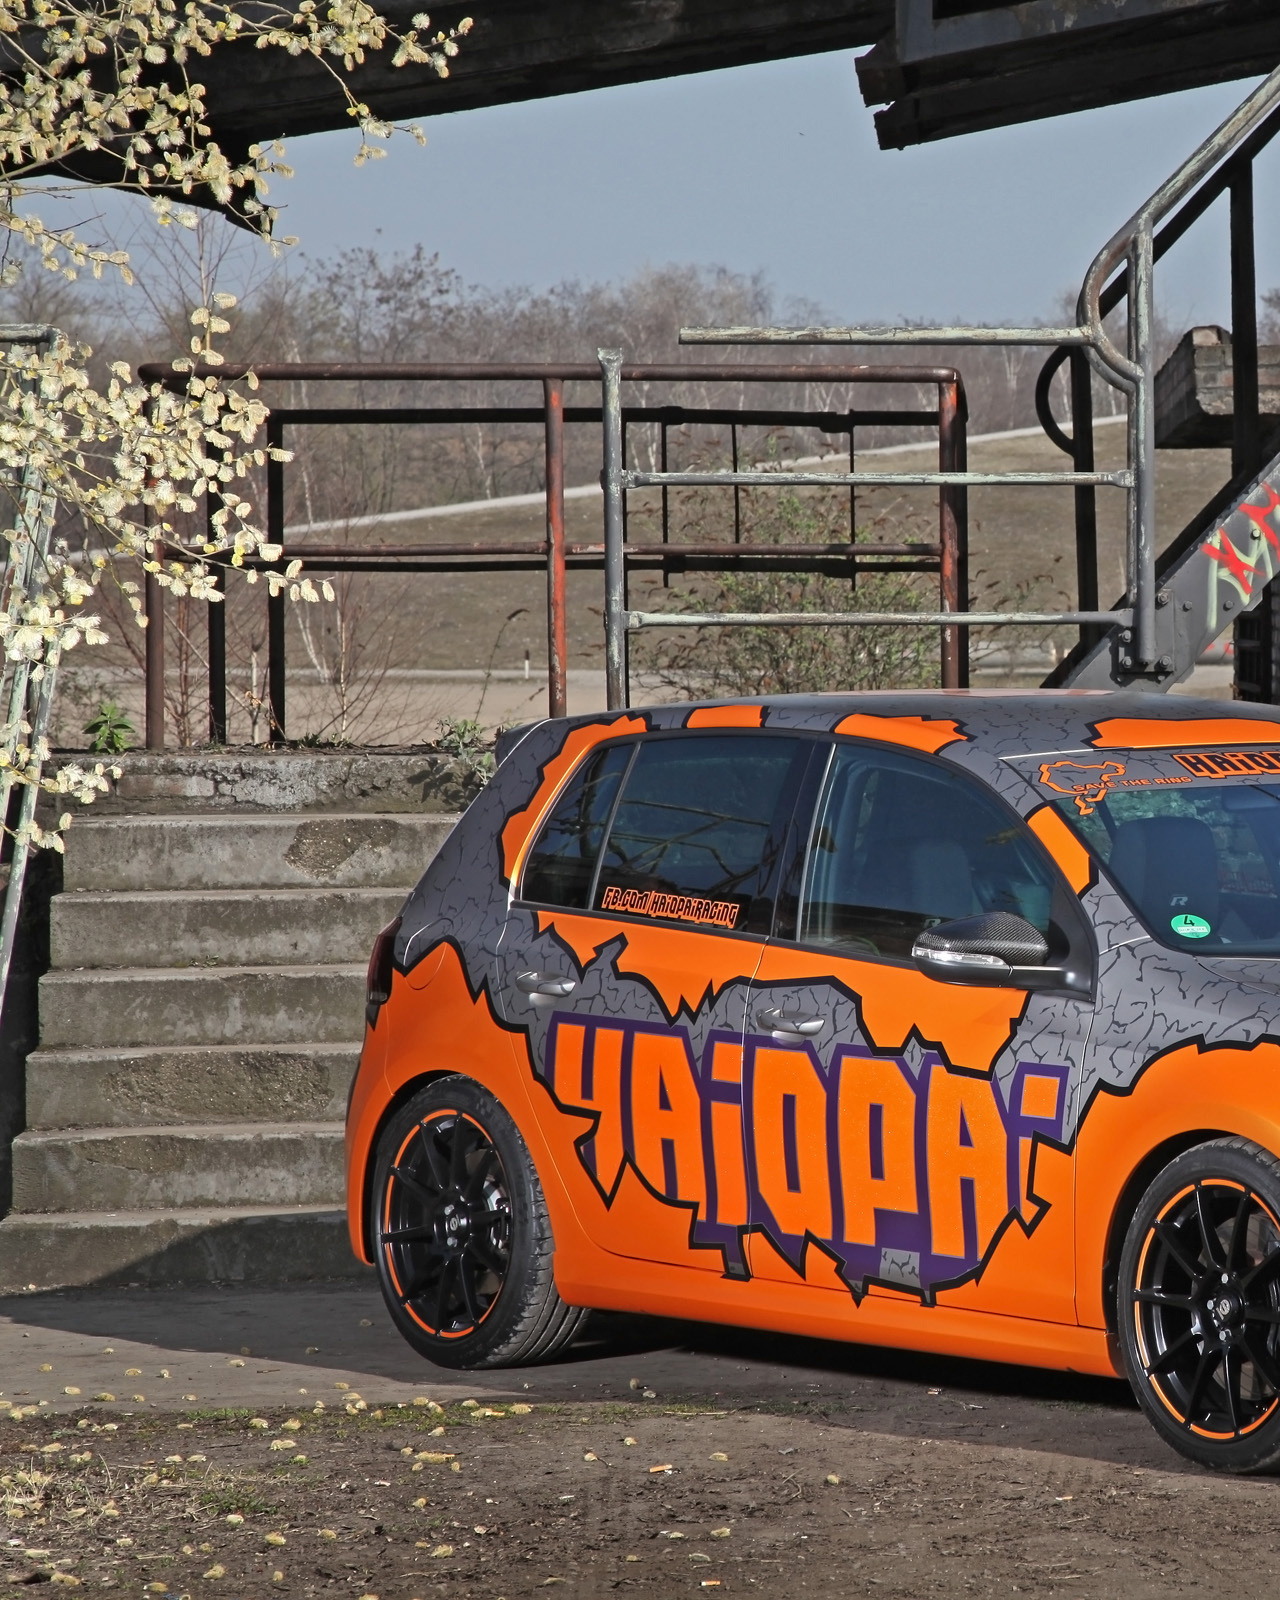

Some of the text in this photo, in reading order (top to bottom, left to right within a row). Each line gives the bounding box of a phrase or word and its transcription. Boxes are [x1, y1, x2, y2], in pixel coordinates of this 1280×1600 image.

[1072, 776, 1192, 792] SAVE THE RING
[1184, 915, 1195, 926] 4
